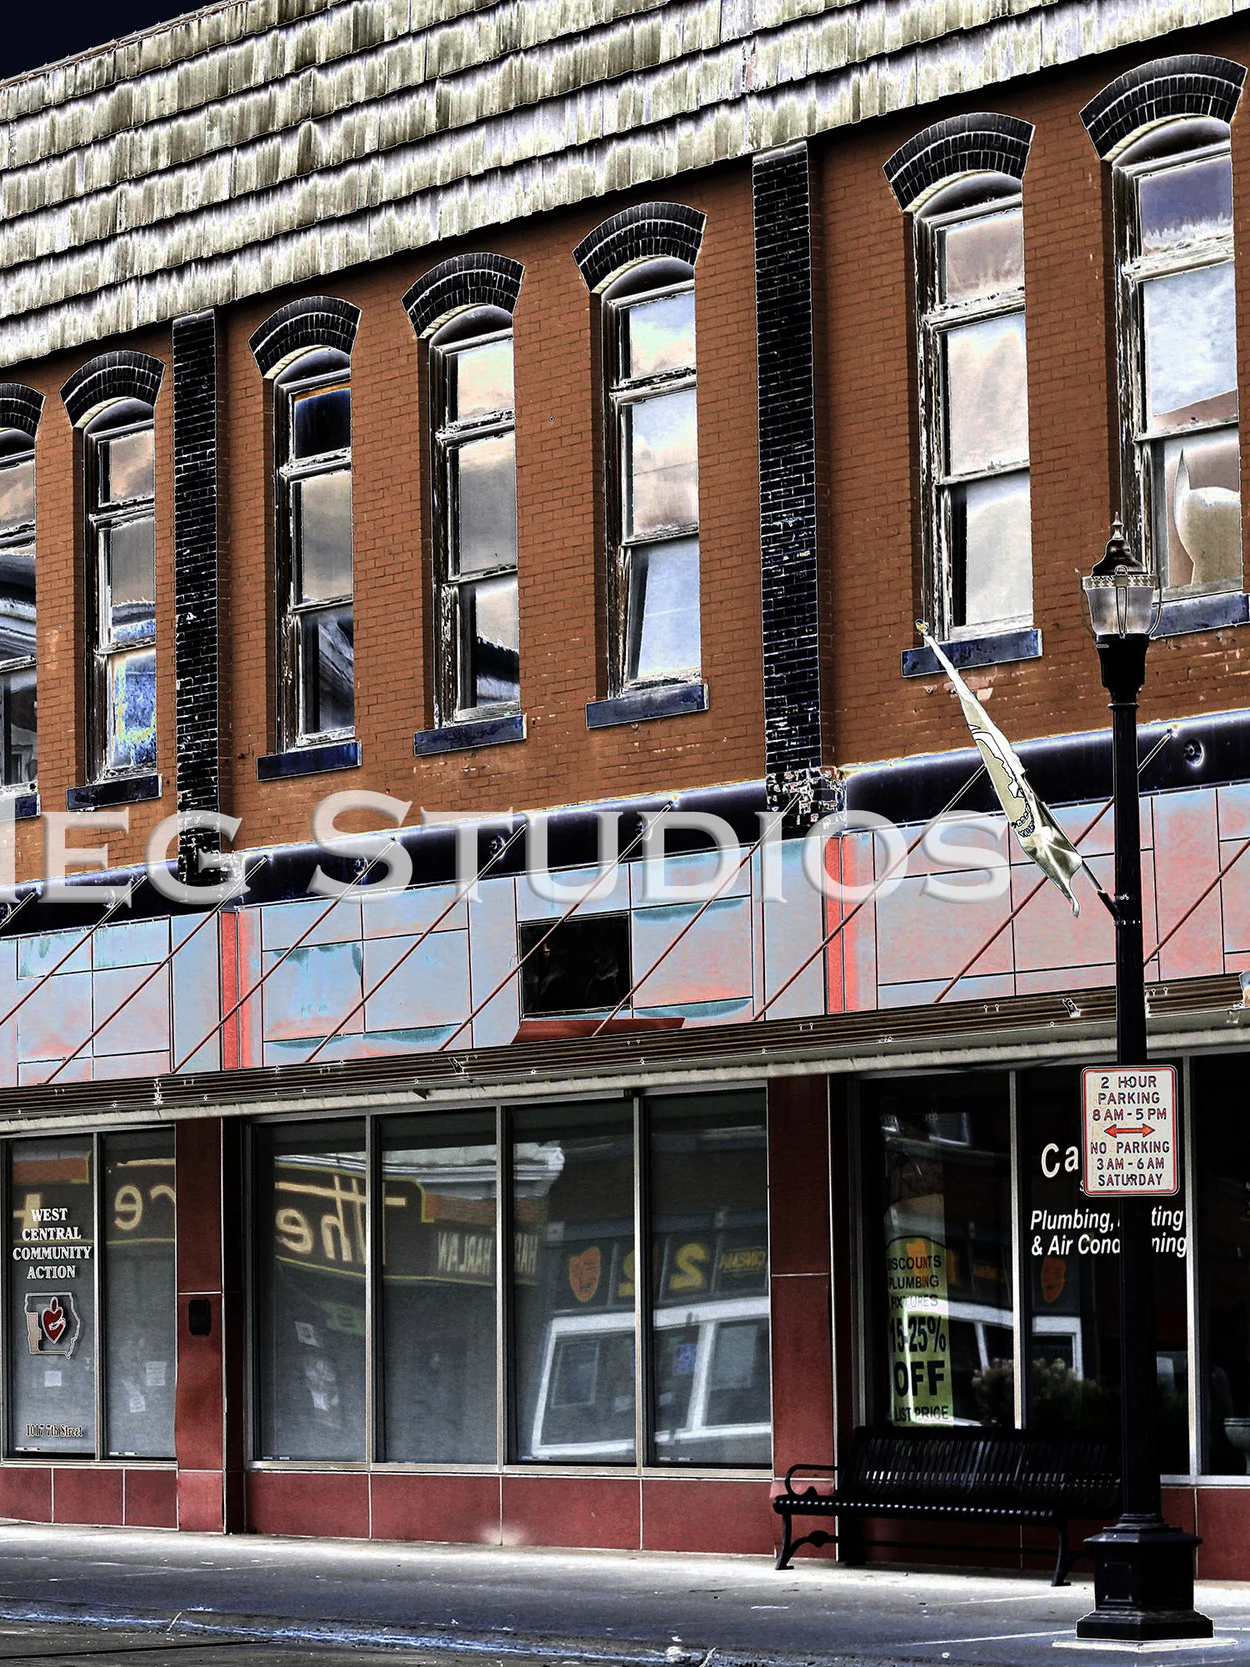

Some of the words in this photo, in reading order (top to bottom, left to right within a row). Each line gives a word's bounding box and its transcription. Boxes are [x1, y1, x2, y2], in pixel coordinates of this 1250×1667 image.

[1101, 1076, 1110, 1089] 2
[1117, 1075, 1157, 1088] HOUR
[1097, 1092, 1161, 1105] PARKING
[1090, 1141, 1107, 1154] NO
[1116, 1141, 1170, 1154] PARKING
[1098, 1173, 1163, 1187] SATURDAY
[31, 1207, 68, 1222] WEST
[1031, 1208, 1114, 1234] Plumbing,
[22, 1226, 81, 1241] CENTRAL
[1031, 1235, 1043, 1256] &
[1047, 1235, 1074, 1255] Air
[12, 1246, 92, 1260] COMMUNITY
[27, 1265, 76, 1279] ACTION
[894, 1360, 945, 1397] OFF
[894, 1406, 912, 1422] LIST
[914, 1405, 949, 1420] PRICE
[26, 1424, 45, 1437] 1017
[46, 1423, 59, 1437] 7th
[60, 1424, 83, 1437] Street
